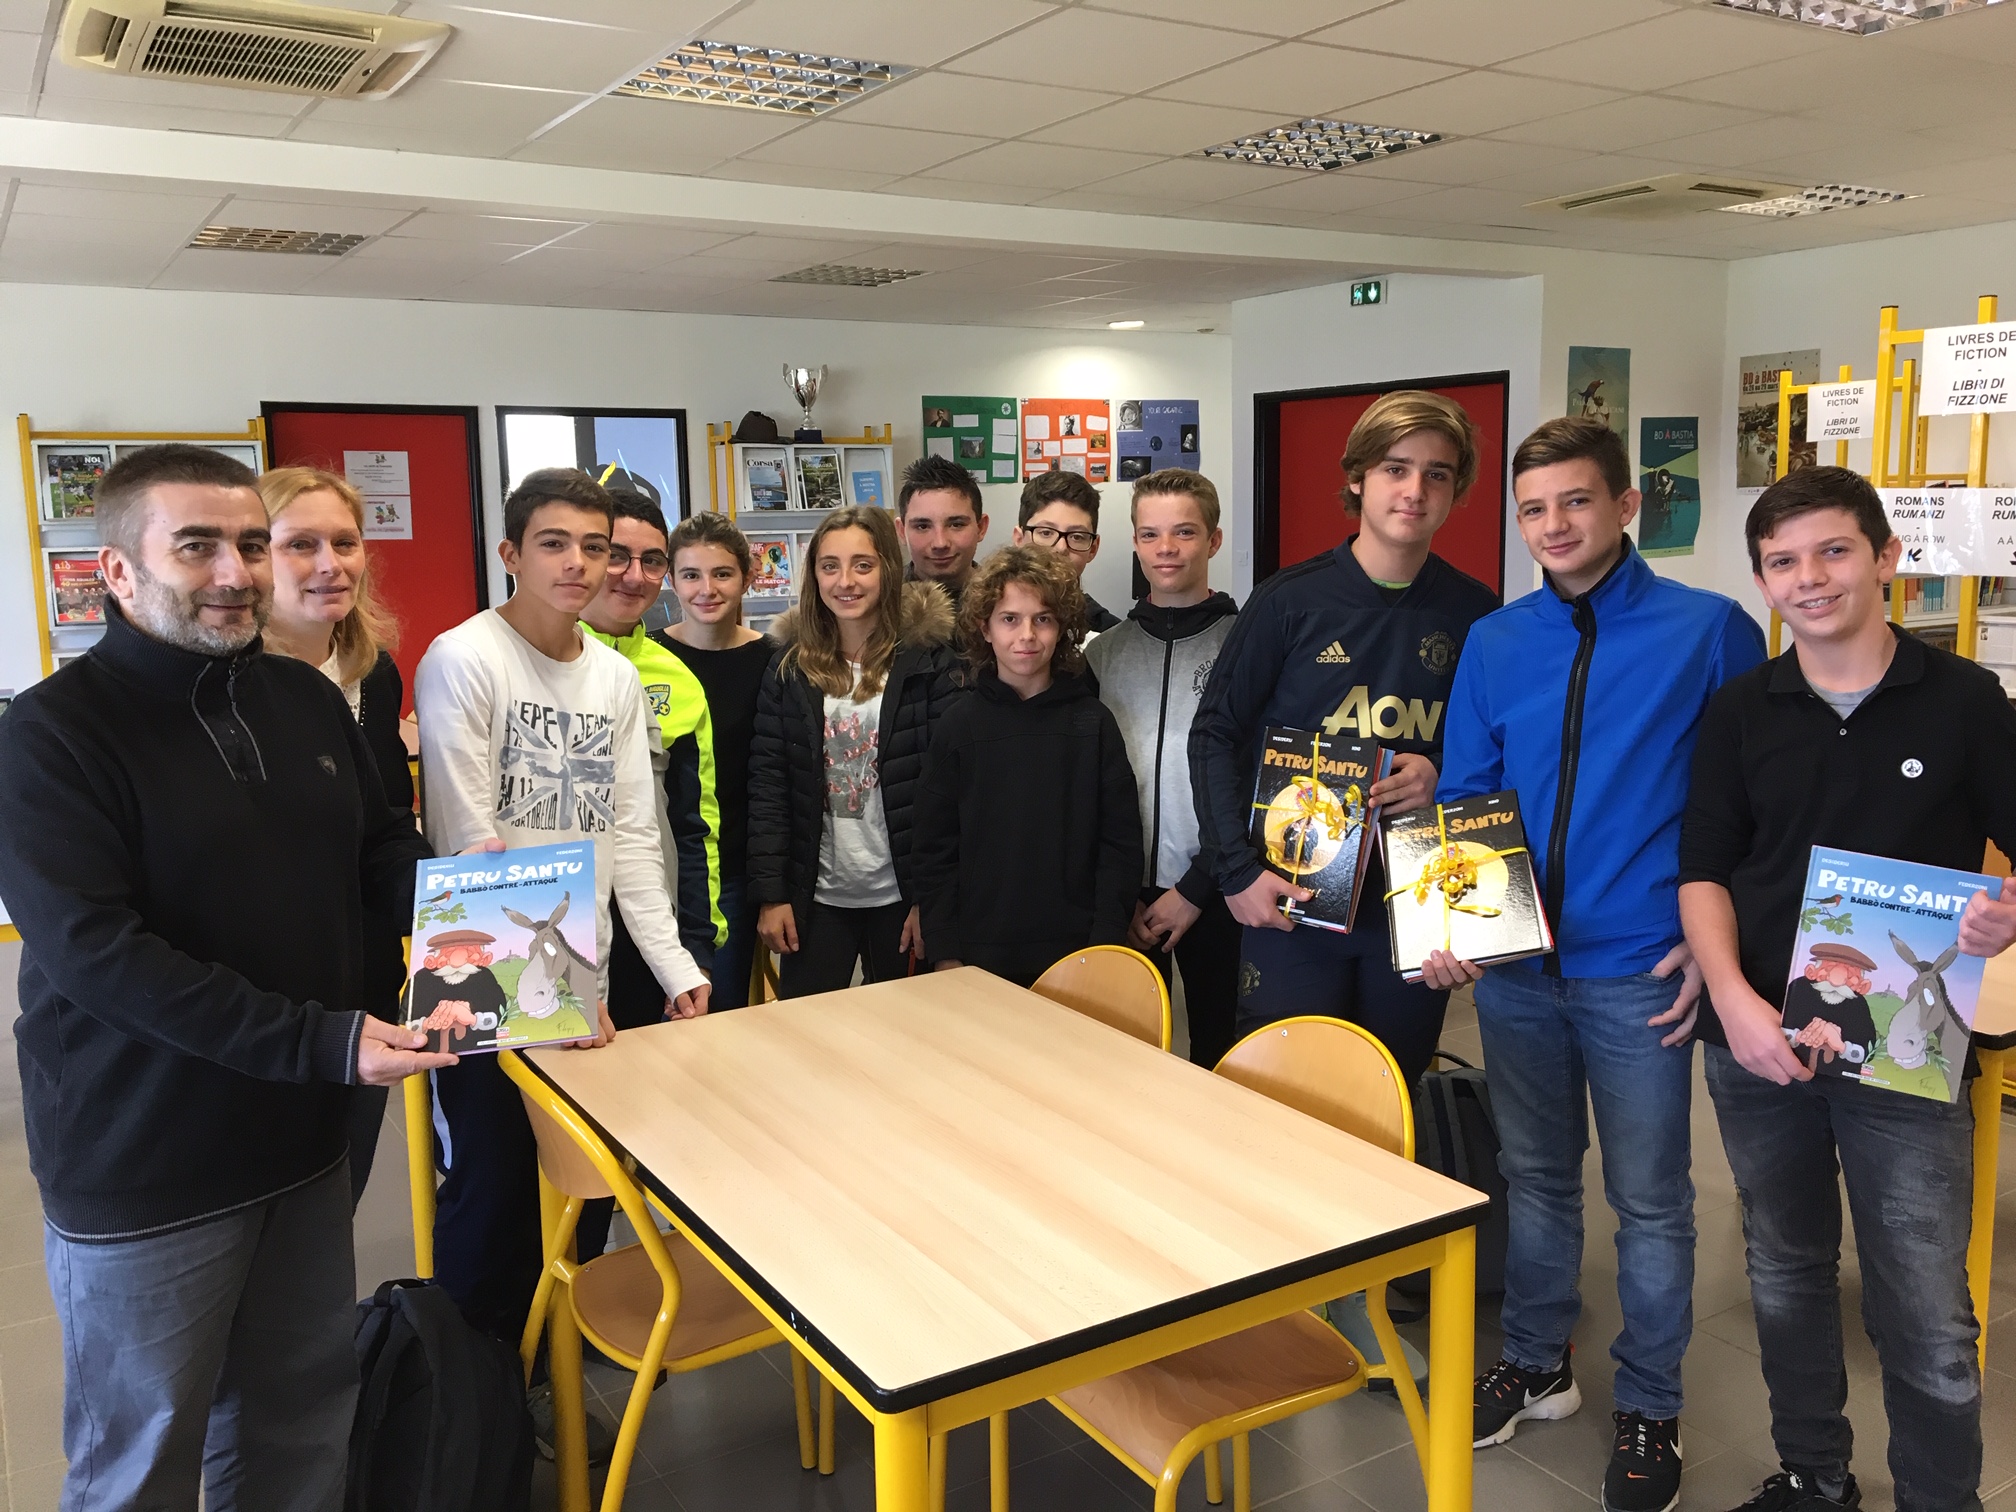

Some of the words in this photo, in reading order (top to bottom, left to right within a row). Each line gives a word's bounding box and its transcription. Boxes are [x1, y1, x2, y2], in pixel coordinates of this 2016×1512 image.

[1948, 332, 1995, 346] LIVRES
[1999, 330, 2016, 342] DE
[1955, 347, 2007, 360] FICTION
[1743, 372, 1753, 385] BD
[1952, 379, 1988, 391] LIBRI
[1990, 378, 2005, 389] DI
[1822, 388, 1851, 398] LIVRES
[1852, 387, 1864, 395] DE
[1827, 398, 1859, 406] FICTION
[1947, 393, 2009, 406] FIZZIONE
[1826, 418, 1848, 426] LIBRI
[1849, 417, 1858, 425] DI
[1654, 430, 1663, 440] BD
[1672, 430, 1694, 439] BASTIA
[1823, 427, 1860, 436] FIZZIONE
[1895, 496, 1945, 506] ROMANS
[1892, 509, 1945, 519] RUMANZI
[1316, 655, 1350, 663] adidas
[1321, 685, 1444, 742] AON
[514, 700, 558, 750] EPE
[1264, 748, 1313, 770] PETRU
[1317, 755, 1368, 779] SANTU
[511, 792, 558, 831] PORTOBELLO
[1449, 811, 1514, 834] SANTU
[426, 870, 501, 890] PETRU
[505, 861, 583, 882] SANTU
[1817, 868, 1896, 899] PETRU
[1899, 883, 1968, 913] SANT
[1850, 896, 1879, 907] BABBÒ
